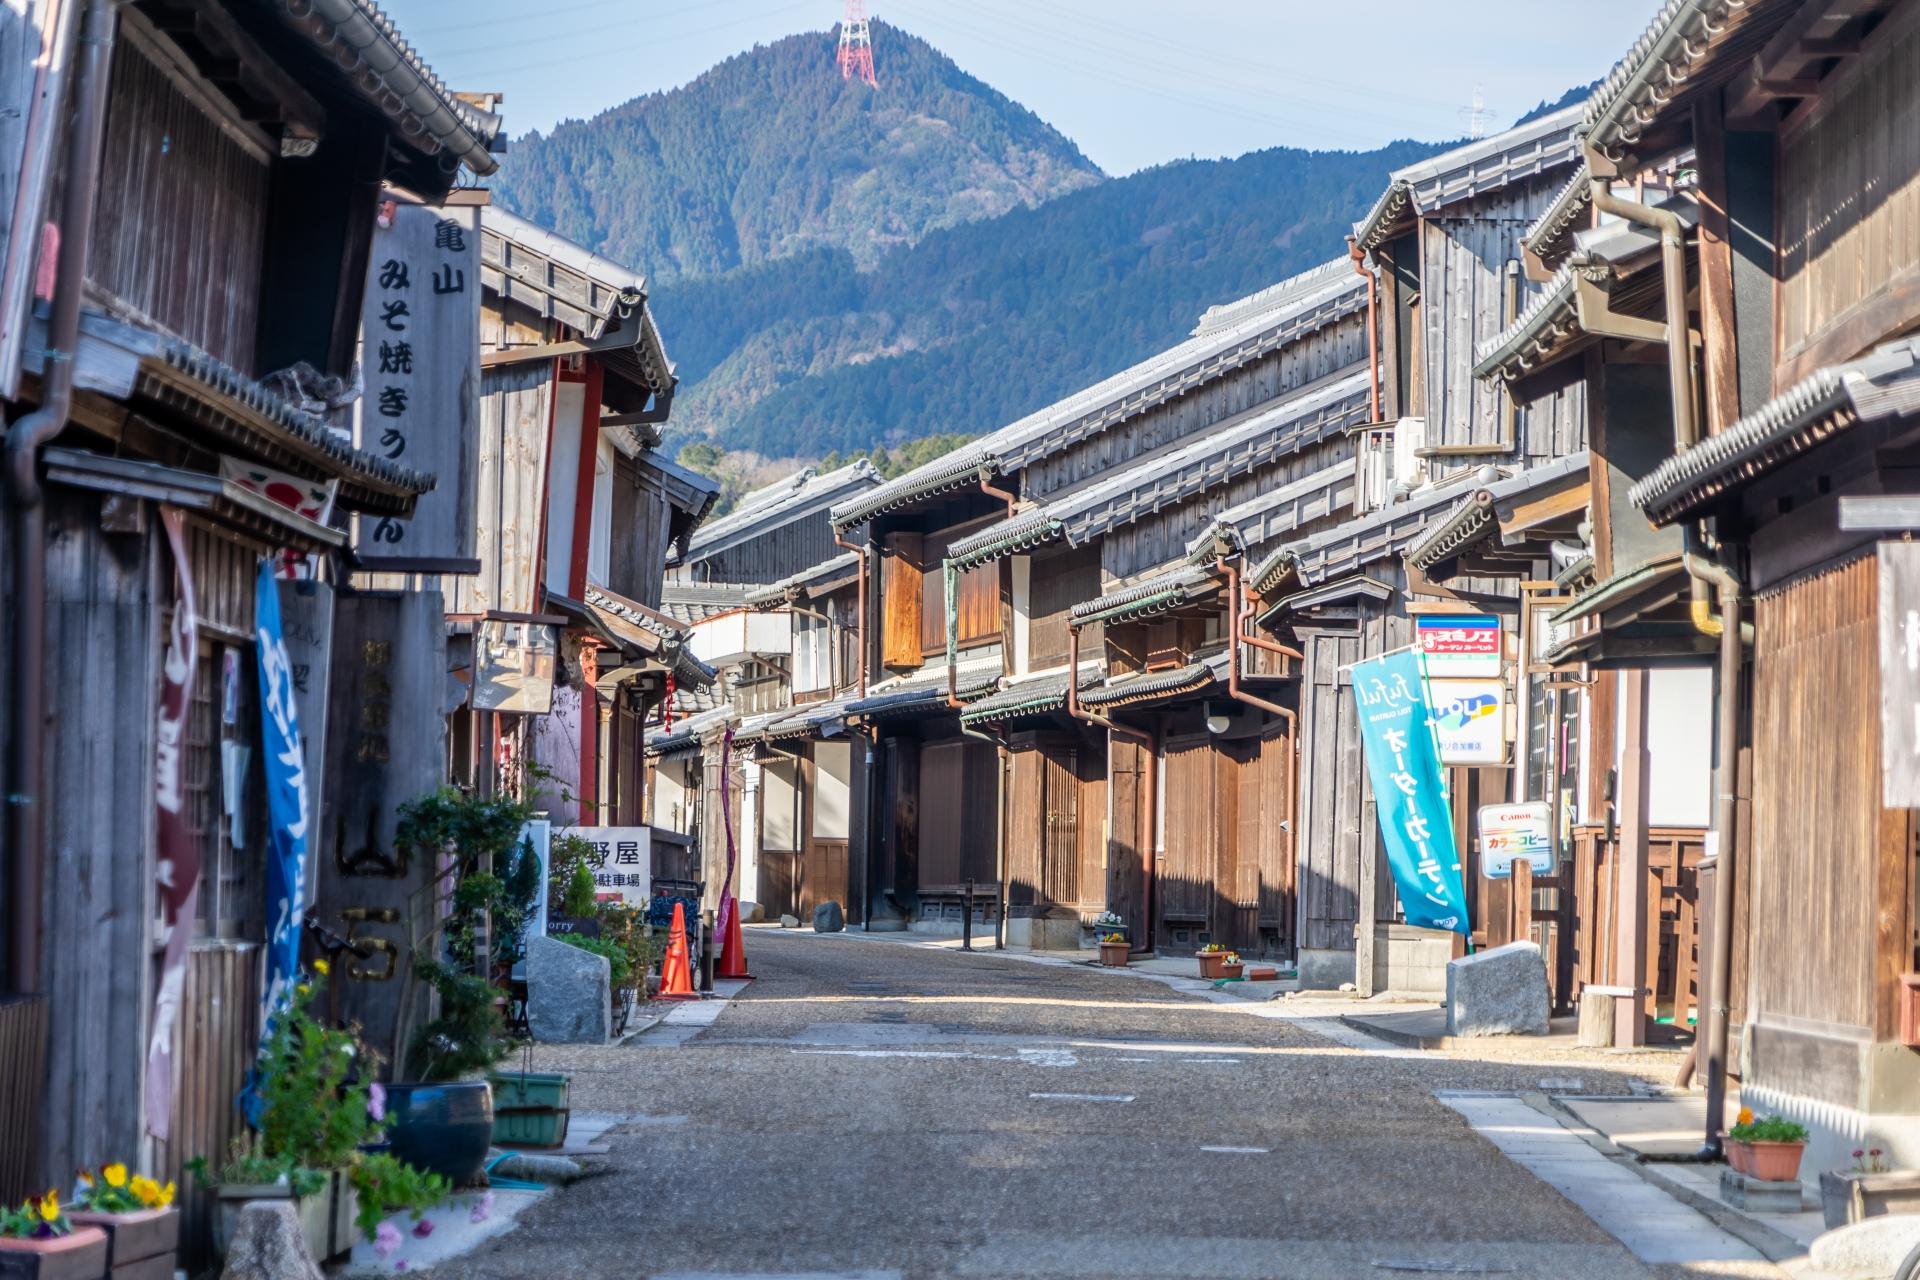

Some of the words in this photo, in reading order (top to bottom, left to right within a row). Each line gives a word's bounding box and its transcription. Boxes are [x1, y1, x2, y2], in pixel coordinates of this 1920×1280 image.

[432, 218, 466, 295] 亀山
[373, 258, 413, 544] みそ焼きうん
[1437, 629, 1494, 642] スミノエ
[1434, 699, 1482, 716] TOLI
[1500, 813, 1531, 822] Canon
[1488, 834, 1548, 849] カラーコピー
[584, 841, 640, 865] 野屋
[594, 873, 640, 888] 駐車場
[548, 921, 574, 933] orry
